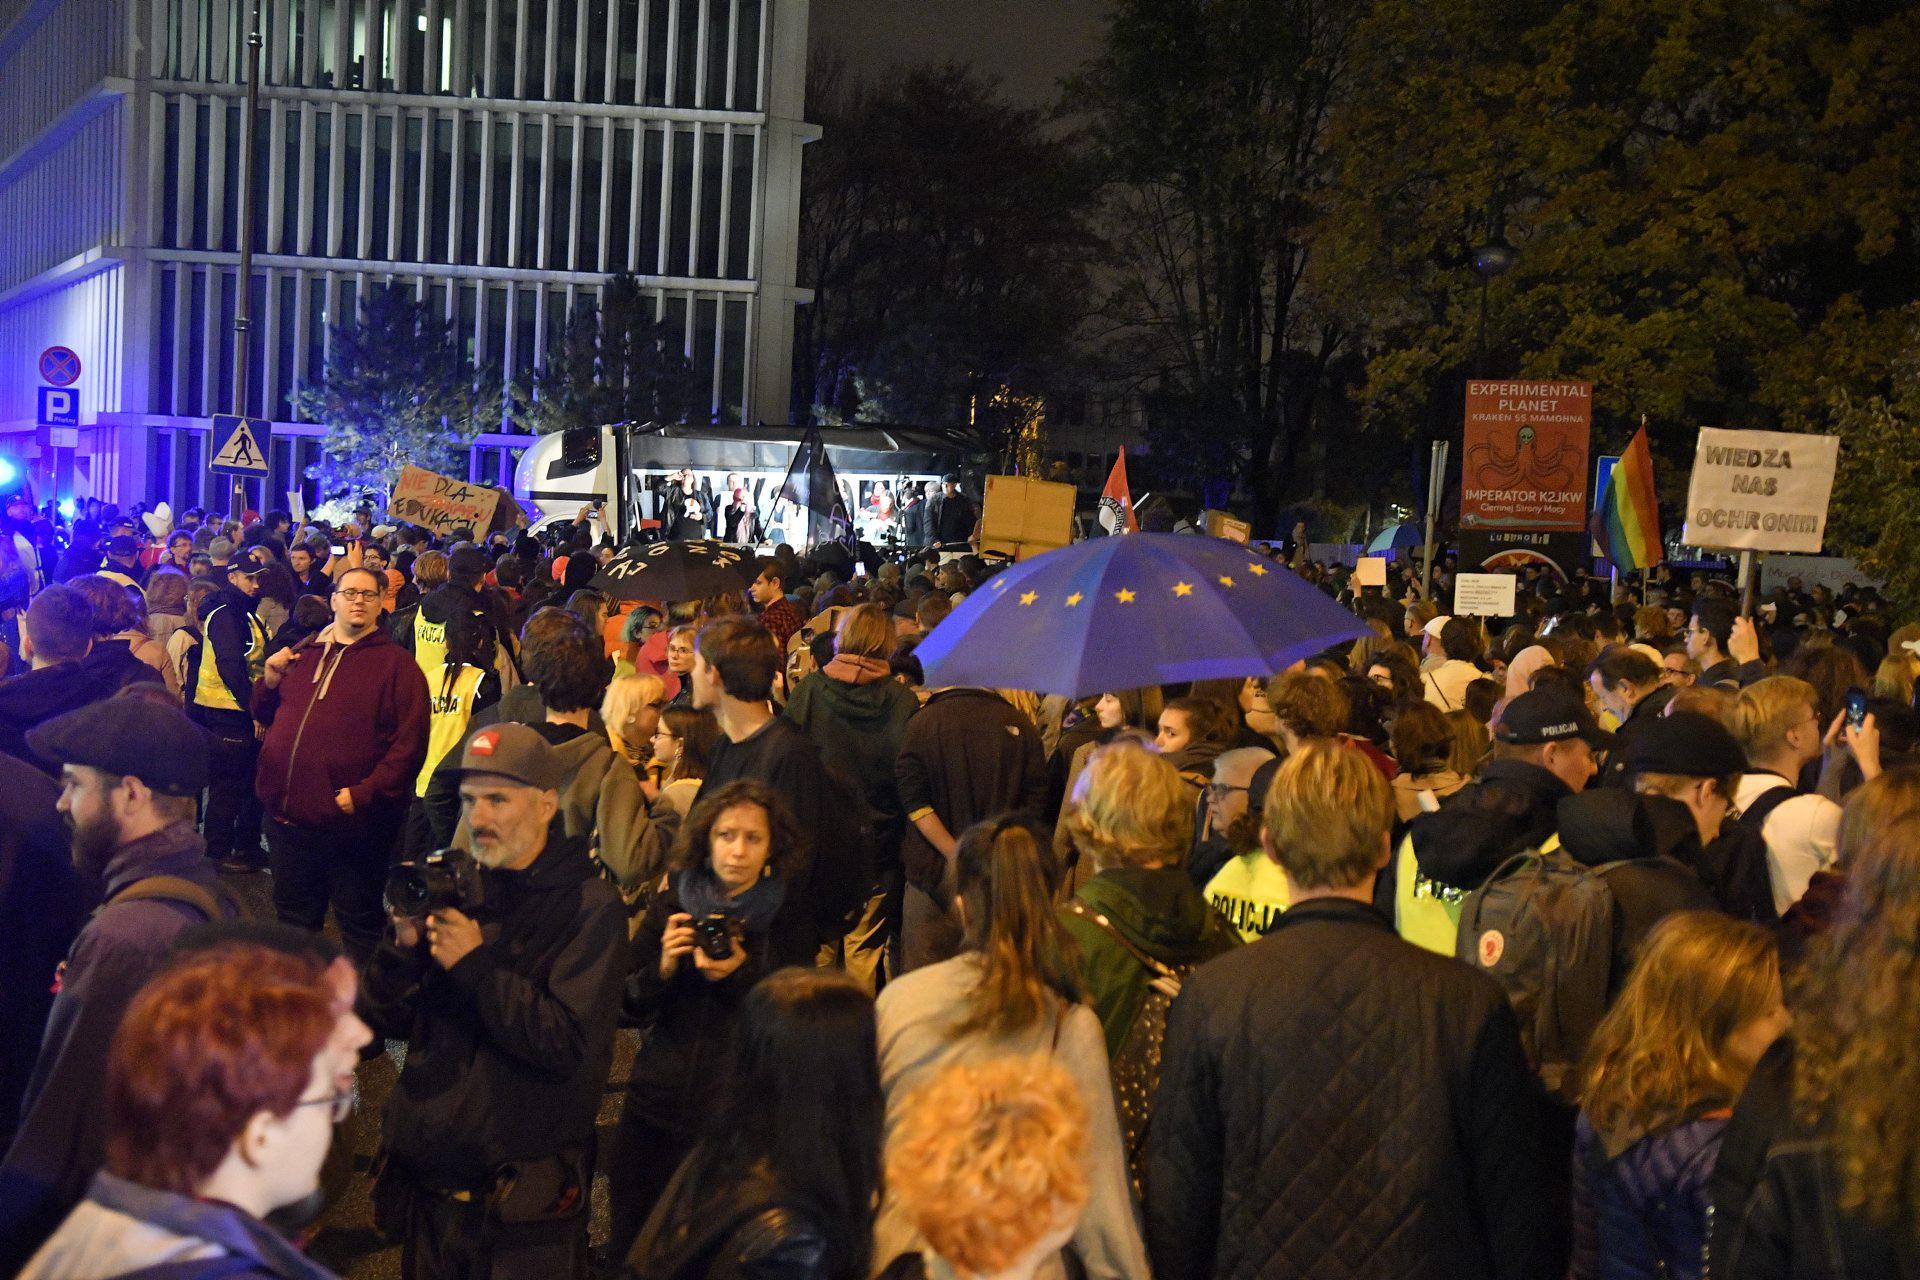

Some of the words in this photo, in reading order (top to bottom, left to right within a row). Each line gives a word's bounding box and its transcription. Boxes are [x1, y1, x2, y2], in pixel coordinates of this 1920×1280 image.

[1470, 384, 1589, 398] EXPERIMENTAL
[46, 391, 71, 422] P
[1499, 400, 1559, 412] PLANET
[1472, 413, 1512, 422] KRAKEN
[1706, 446, 1792, 469] WIEDZA
[434, 477, 474, 502] DLA
[1731, 474, 1778, 496] NAS
[1465, 490, 1537, 502] IMPERATOR
[1541, 721, 1579, 736] POLICJA
